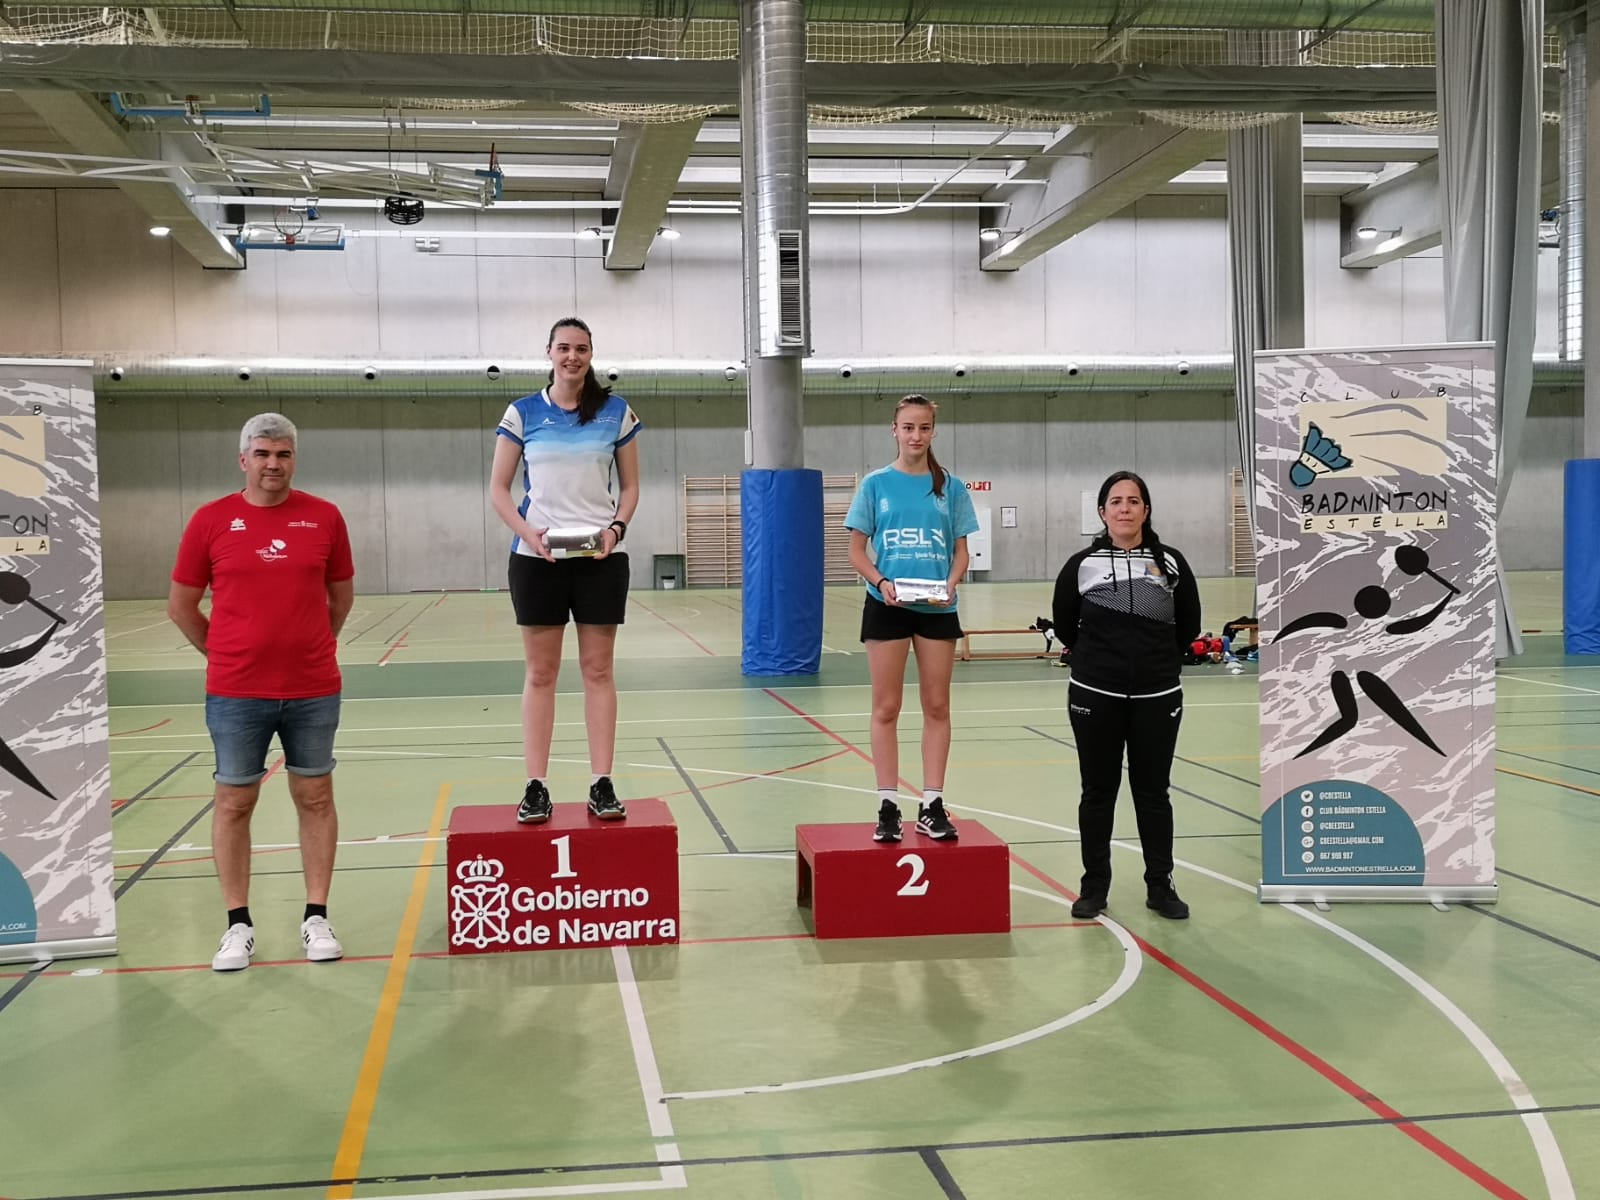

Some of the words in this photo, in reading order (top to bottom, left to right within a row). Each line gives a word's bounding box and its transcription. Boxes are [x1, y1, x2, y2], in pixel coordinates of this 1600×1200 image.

[1300, 489, 1448, 515] BADMINTON
[1303, 514, 1446, 531] ESTELLA
[883, 527, 932, 550] RSL
[550, 835, 578, 879] 1
[896, 853, 930, 896] 2
[511, 884, 649, 912] Gobierno
[512, 919, 551, 946] de
[559, 917, 677, 944] Navarra
